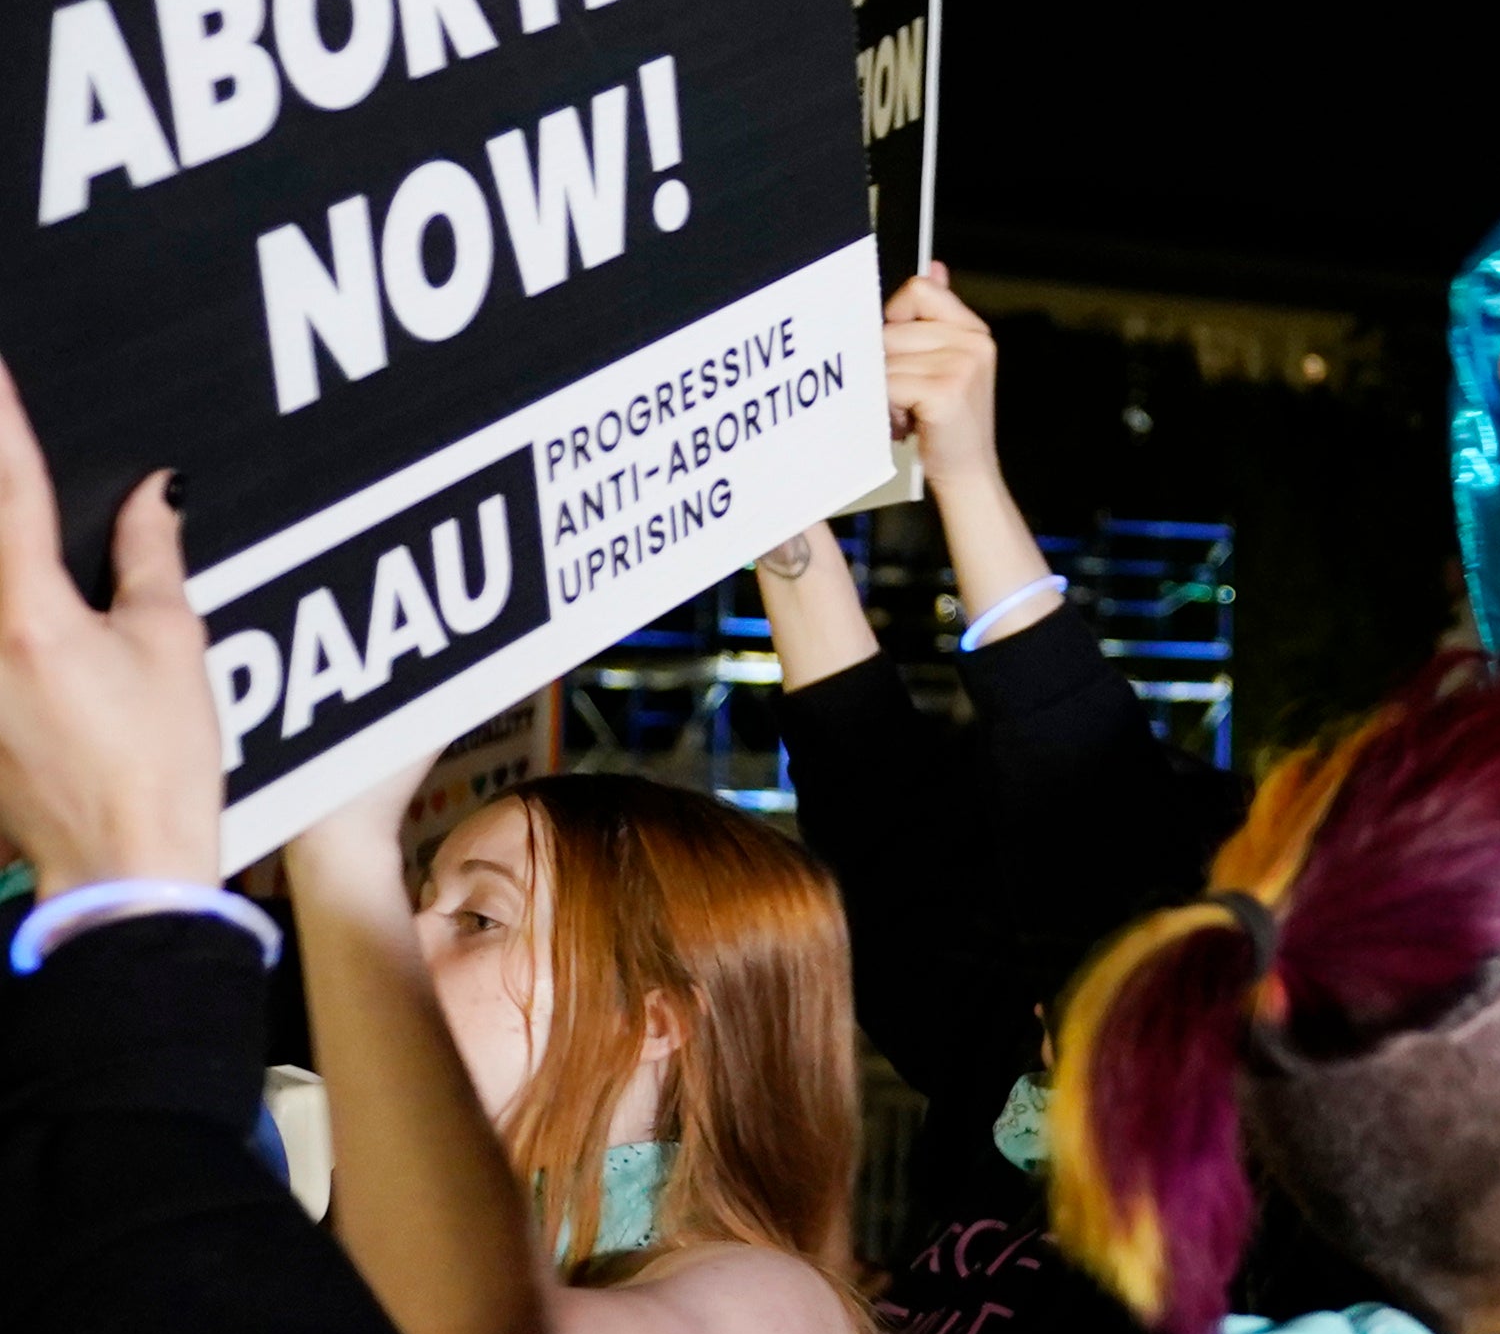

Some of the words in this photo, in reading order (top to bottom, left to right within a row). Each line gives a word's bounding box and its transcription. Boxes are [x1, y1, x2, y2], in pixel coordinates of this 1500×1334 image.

[256, 54, 691, 416] NOW!
[545, 316, 796, 483] PROGRESSIVE
[553, 352, 845, 547] ANTI-ABORTION
[203, 493, 513, 773] PAAU
[558, 477, 733, 605] UPRISING
